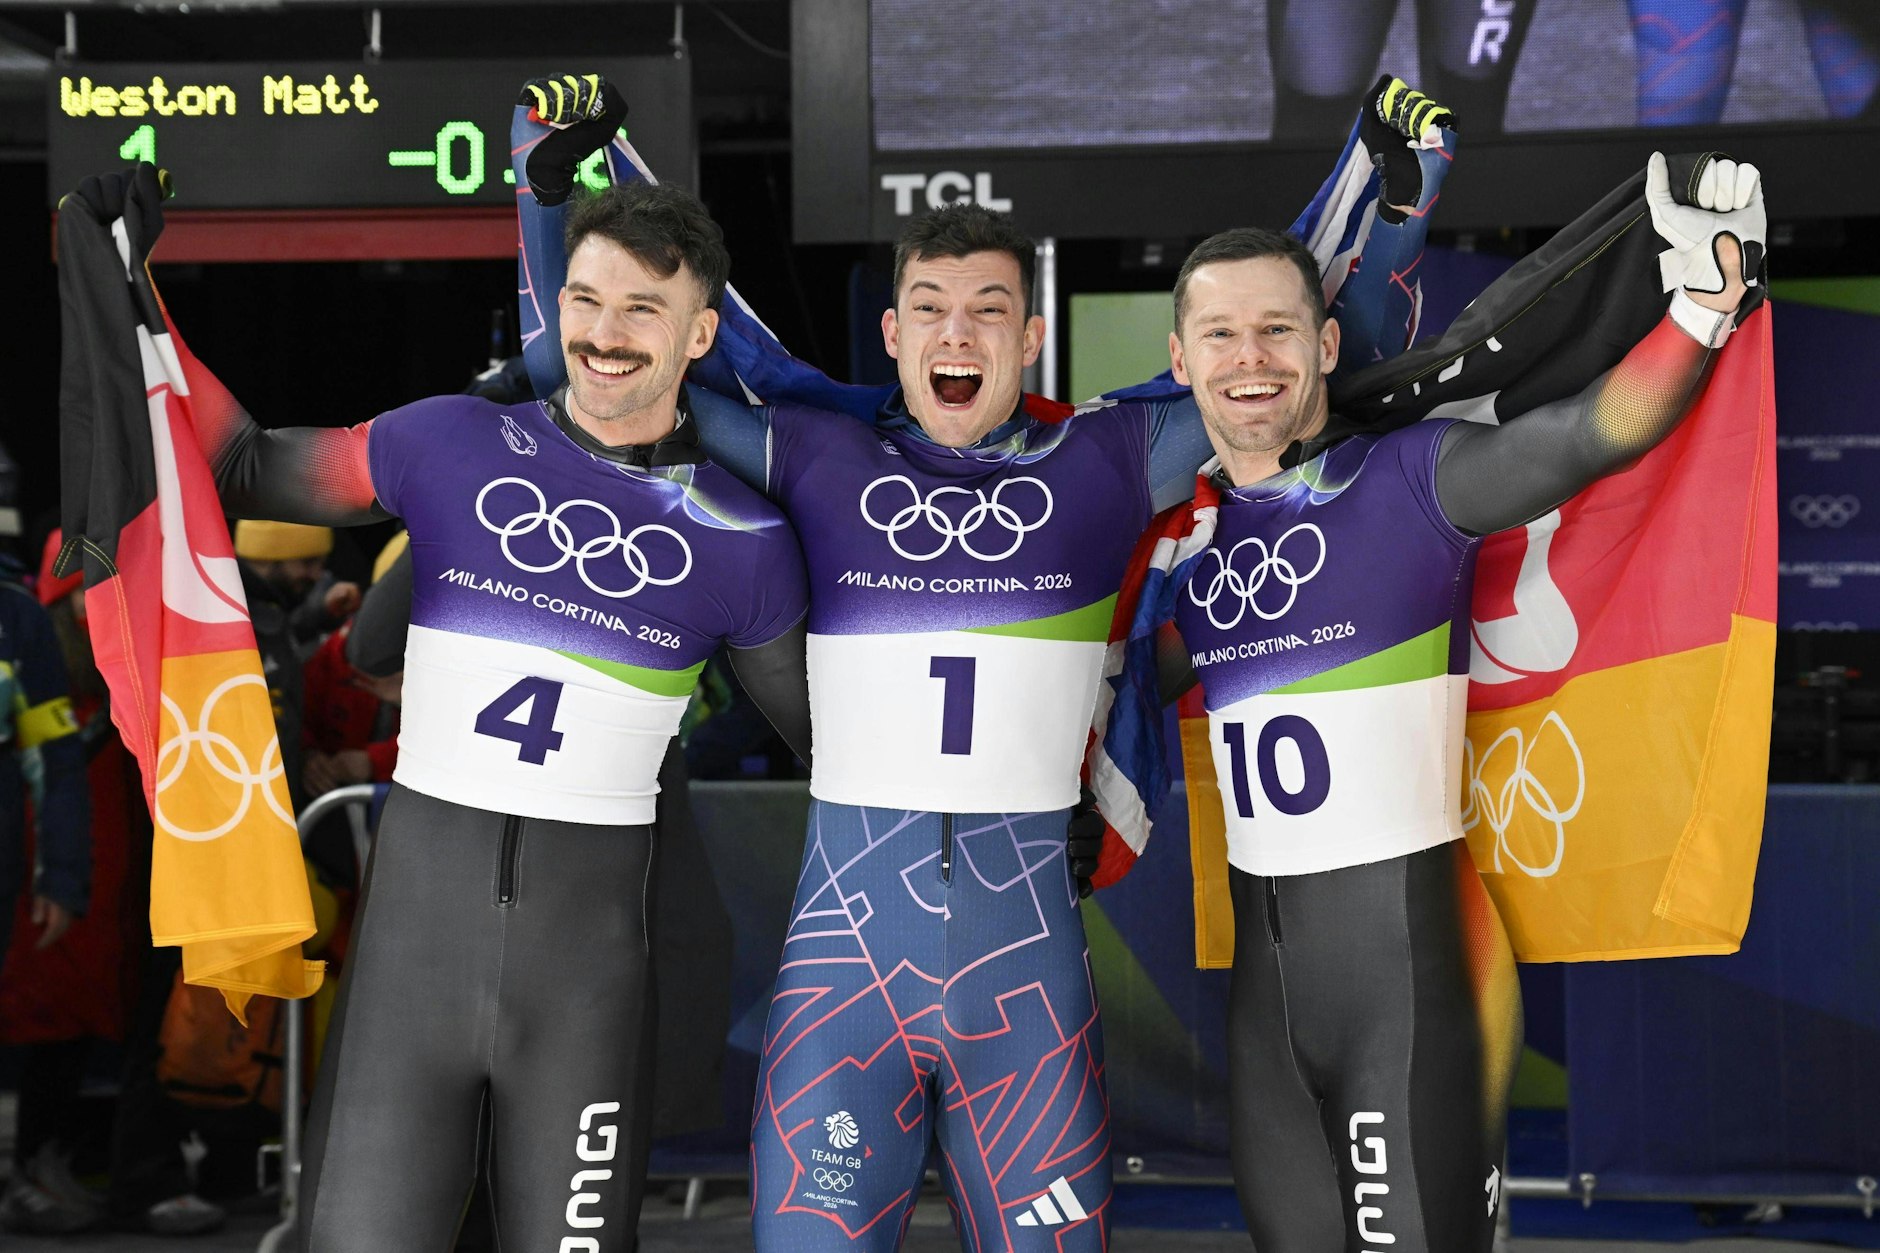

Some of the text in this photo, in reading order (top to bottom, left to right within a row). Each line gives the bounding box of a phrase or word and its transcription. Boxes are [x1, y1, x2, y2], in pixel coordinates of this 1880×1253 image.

[60, 74, 379, 116] Weston Matt
[119, 125, 155, 165] 1
[880, 171, 1013, 216] TCL
[836, 570, 1073, 594] MILANO CORTINA 2026
[438, 567, 682, 650] MILANO CORTINA 2026
[1191, 620, 1356, 669] MILANO CORTINA 2026
[473, 675, 565, 766] 4
[928, 654, 977, 756] 1
[1222, 713, 1332, 819] 10
[560, 1101, 621, 1253] GE
[811, 1148, 862, 1169] TEAM GB
[802, 1191, 859, 1207] MILANO CORTINA
[823, 1201, 838, 1209] 2026
